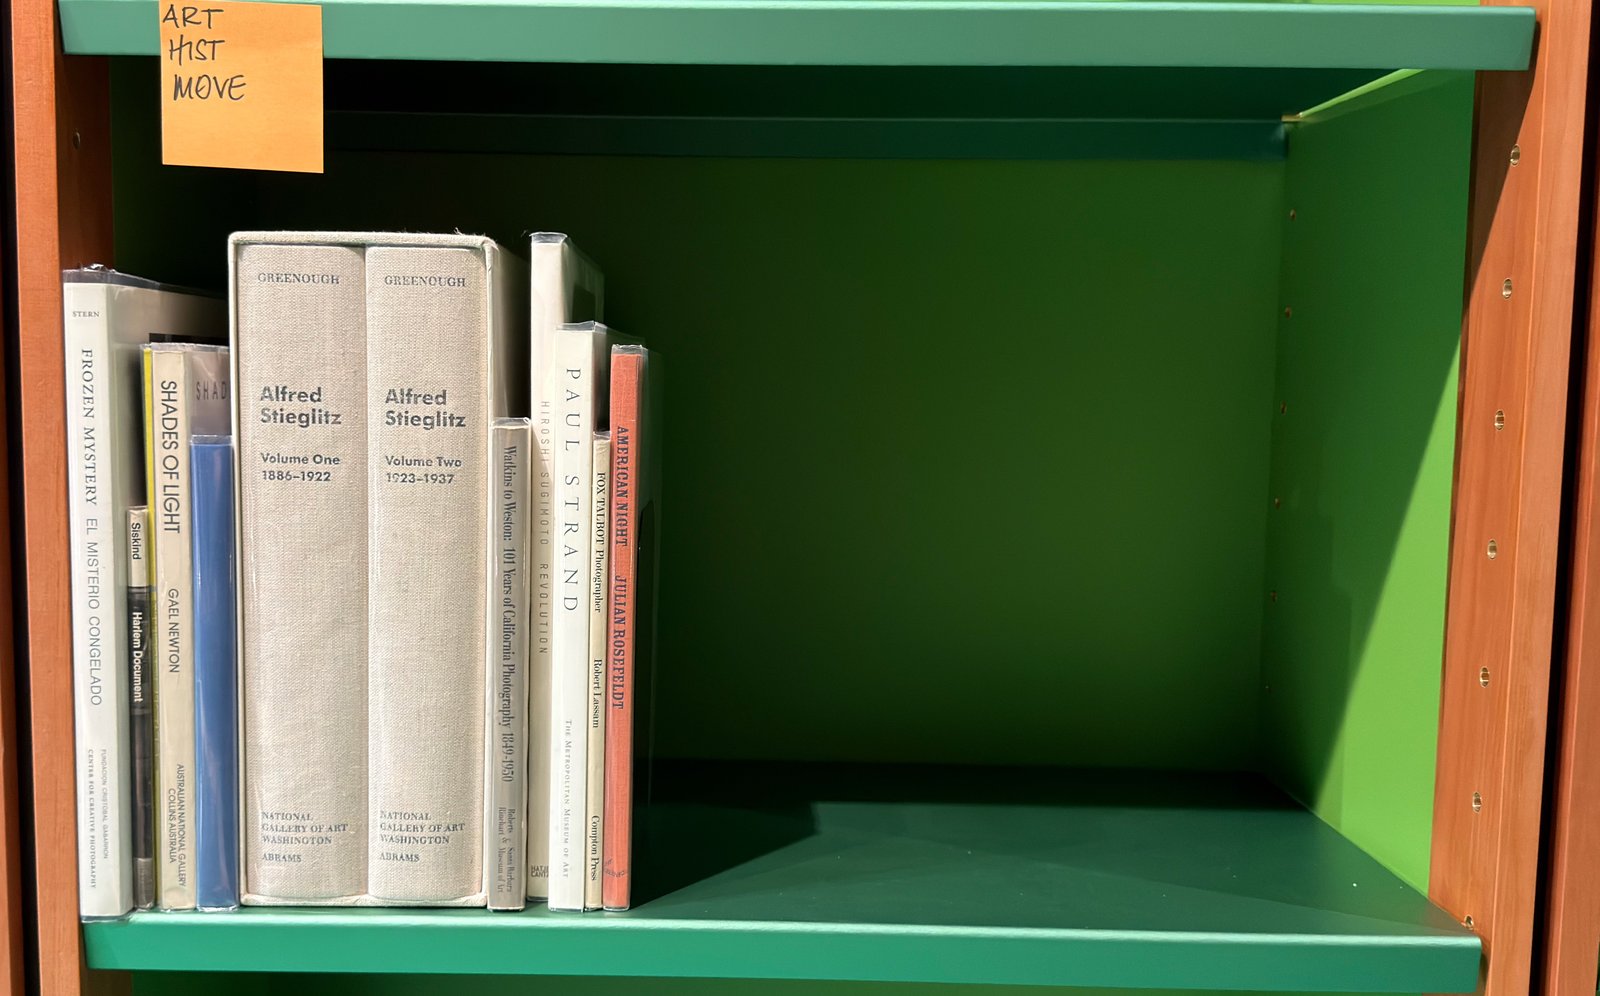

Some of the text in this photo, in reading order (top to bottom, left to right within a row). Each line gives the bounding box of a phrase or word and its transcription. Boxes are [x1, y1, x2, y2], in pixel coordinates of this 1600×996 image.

[163, 4, 224, 29] ART
[169, 34, 225, 66] HIST
[174, 74, 246, 100] MOVE
[258, 273, 340, 285] GREENOUGH
[385, 275, 466, 287] GREENOUGH
[196, 381, 226, 400] SHAD
[260, 386, 322, 403] Alfred
[385, 389, 447, 405] Alfred
[260, 408, 342, 428] Stieglitz
[385, 410, 466, 430] Stieglitz
[161, 380, 180, 534] SHADES OF LIGHT
[260, 452, 340, 465] Volume One
[385, 455, 461, 468] Volume Two
[564, 368, 581, 611] PAUL STRAND
[615, 426, 629, 546] AMERICAN NIGHT
[81, 349, 101, 706] FROZEN MYSTERY EL MISTERIO CONGELADO
[539, 401, 550, 654] HIROSHI SUGIMOTO REVOLUTION
[131, 522, 142, 560] Siskind
[593, 472, 606, 613] FOX TALBOT Photographer
[498, 446, 517, 782] Watkins to Weston: 101 Years of California Photography 1849-1950
[168, 588, 180, 673] GAEL NEWTON
[612, 575, 627, 710] JULIAN ROSEFELDT
[132, 612, 144, 702] Harlem Document
[593, 659, 602, 728] Robert Lassam
[168, 788, 177, 864] COLLINS AUSTRALIA
[176, 764, 187, 886] AUSTRALIAN NATIONAL GALLERY
[261, 811, 313, 821] NATIONAL
[261, 823, 349, 833] GALLERY OF ART
[380, 811, 431, 821] NATIONAL
[380, 823, 466, 833] GALLERY OF ART
[261, 835, 332, 845] WASHINGTON
[380, 835, 450, 844] WASHINGTON
[589, 815, 600, 881] Compton Press
[262, 853, 302, 863] ABRAMS
[379, 852, 420, 862] ABRAMS
